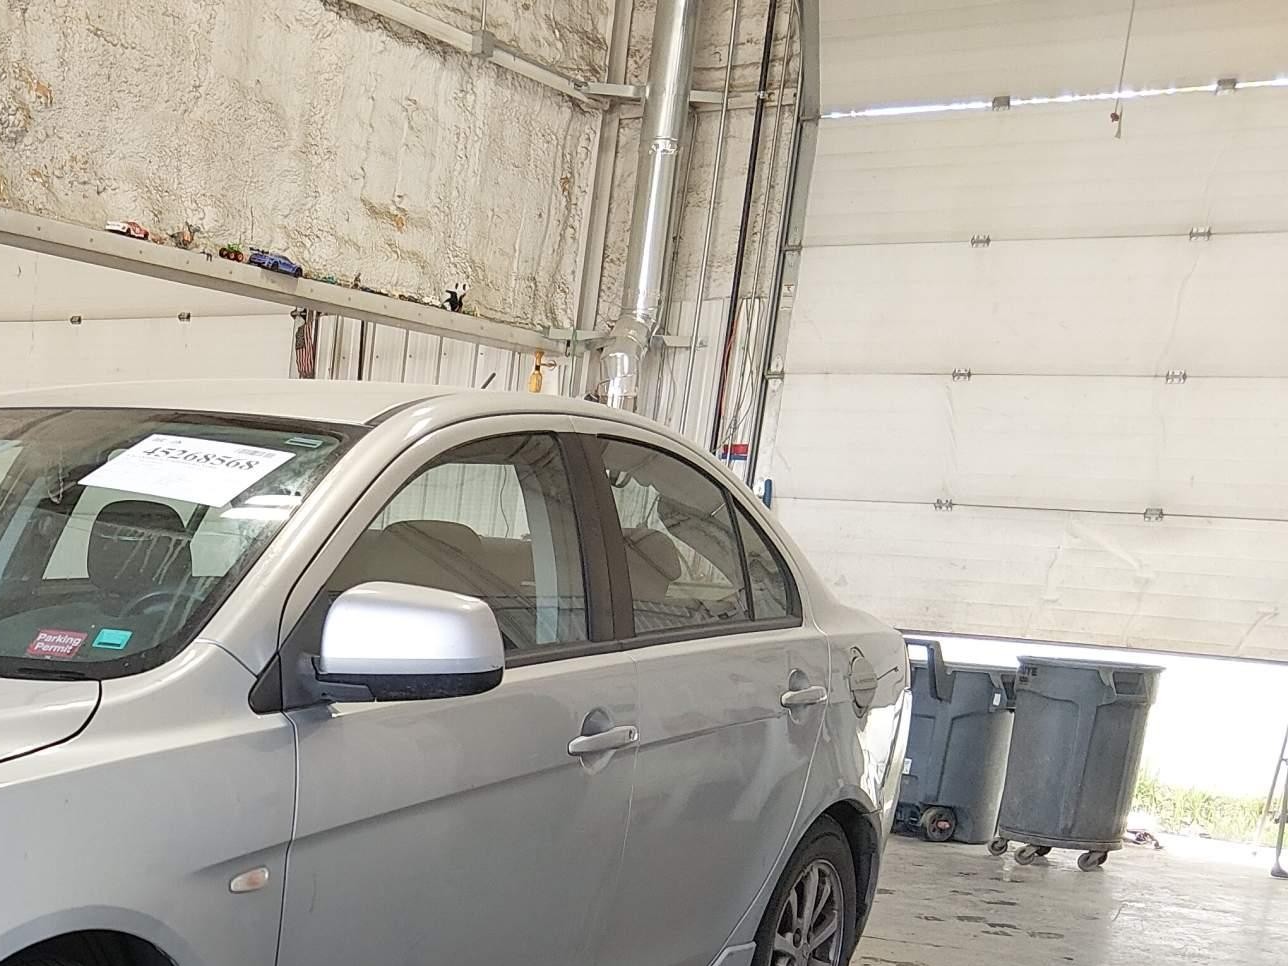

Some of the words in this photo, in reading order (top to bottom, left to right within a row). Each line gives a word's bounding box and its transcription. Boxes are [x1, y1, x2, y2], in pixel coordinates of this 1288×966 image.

[143, 446, 260, 471] 45268568
[37, 632, 82, 647] Parking
[34, 641, 73, 654] Permit
